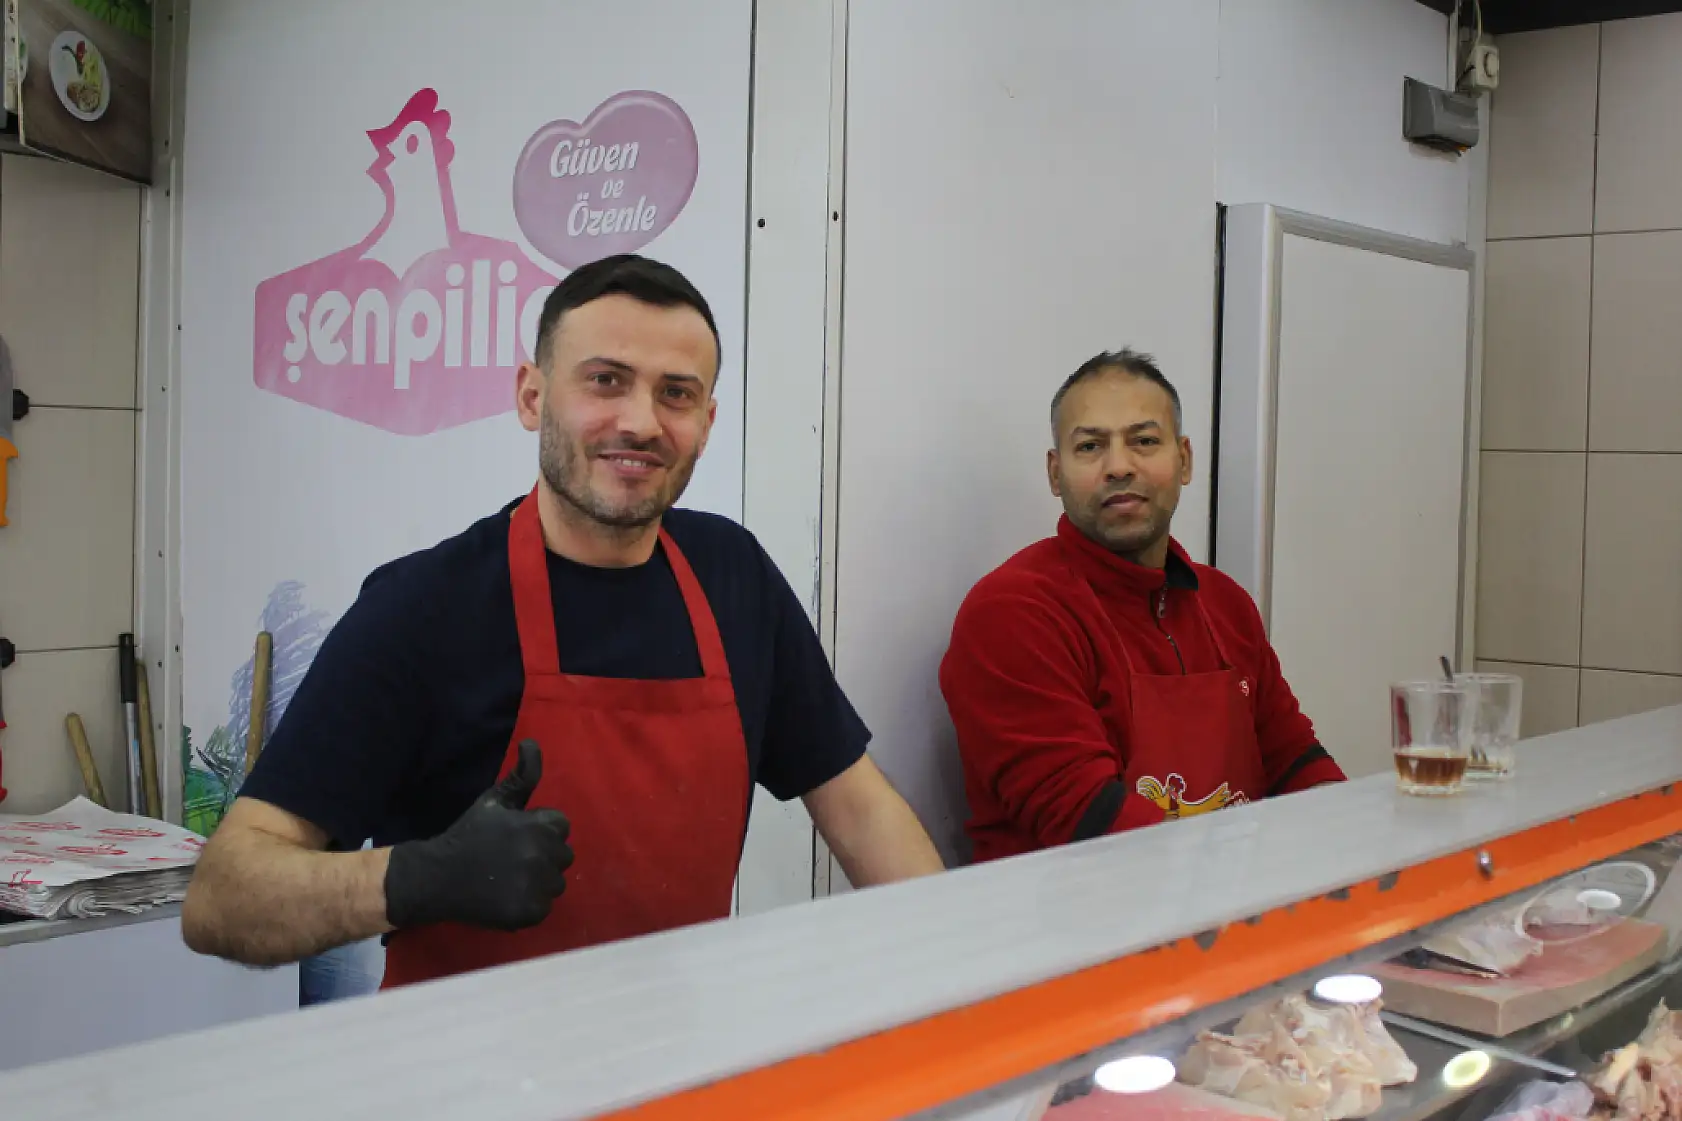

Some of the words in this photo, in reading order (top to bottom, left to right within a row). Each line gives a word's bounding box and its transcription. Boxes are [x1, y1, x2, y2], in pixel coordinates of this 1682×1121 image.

[550, 139, 639, 178] Güven
[600, 179, 624, 199] ve
[566, 191, 658, 237] Özenle
